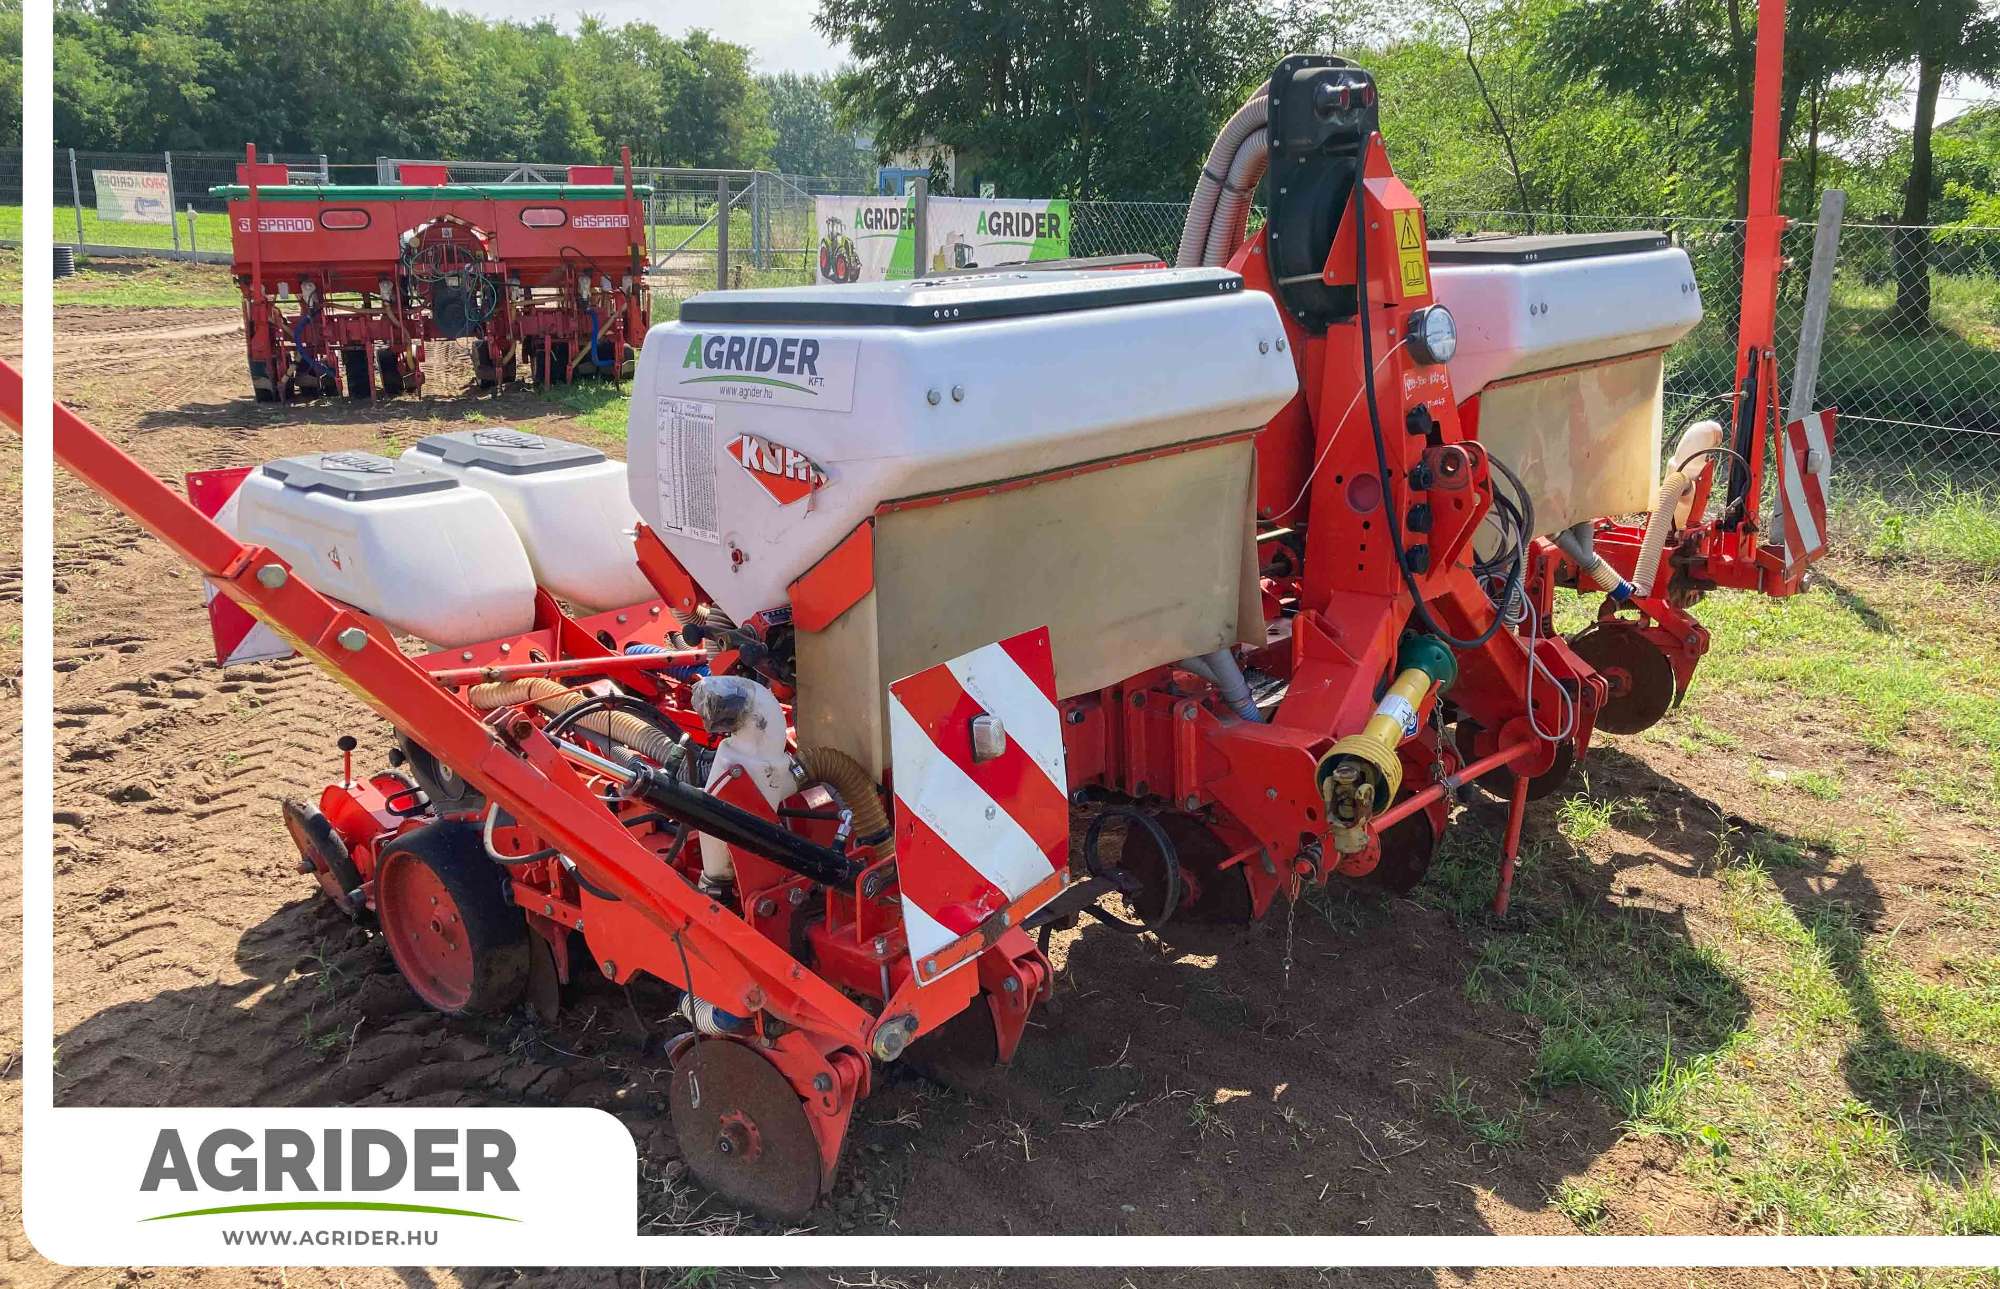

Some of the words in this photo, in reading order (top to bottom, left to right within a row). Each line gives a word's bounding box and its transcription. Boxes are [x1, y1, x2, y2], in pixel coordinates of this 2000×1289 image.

[239, 218, 314, 232] GSPARDO
[573, 215, 629, 228] GASPARD
[855, 207, 916, 230] AGRIDER
[976, 210, 1061, 239] AGRIDER
[682, 334, 820, 376] AGRIDER
[719, 384, 773, 400] www.agrider.hu
